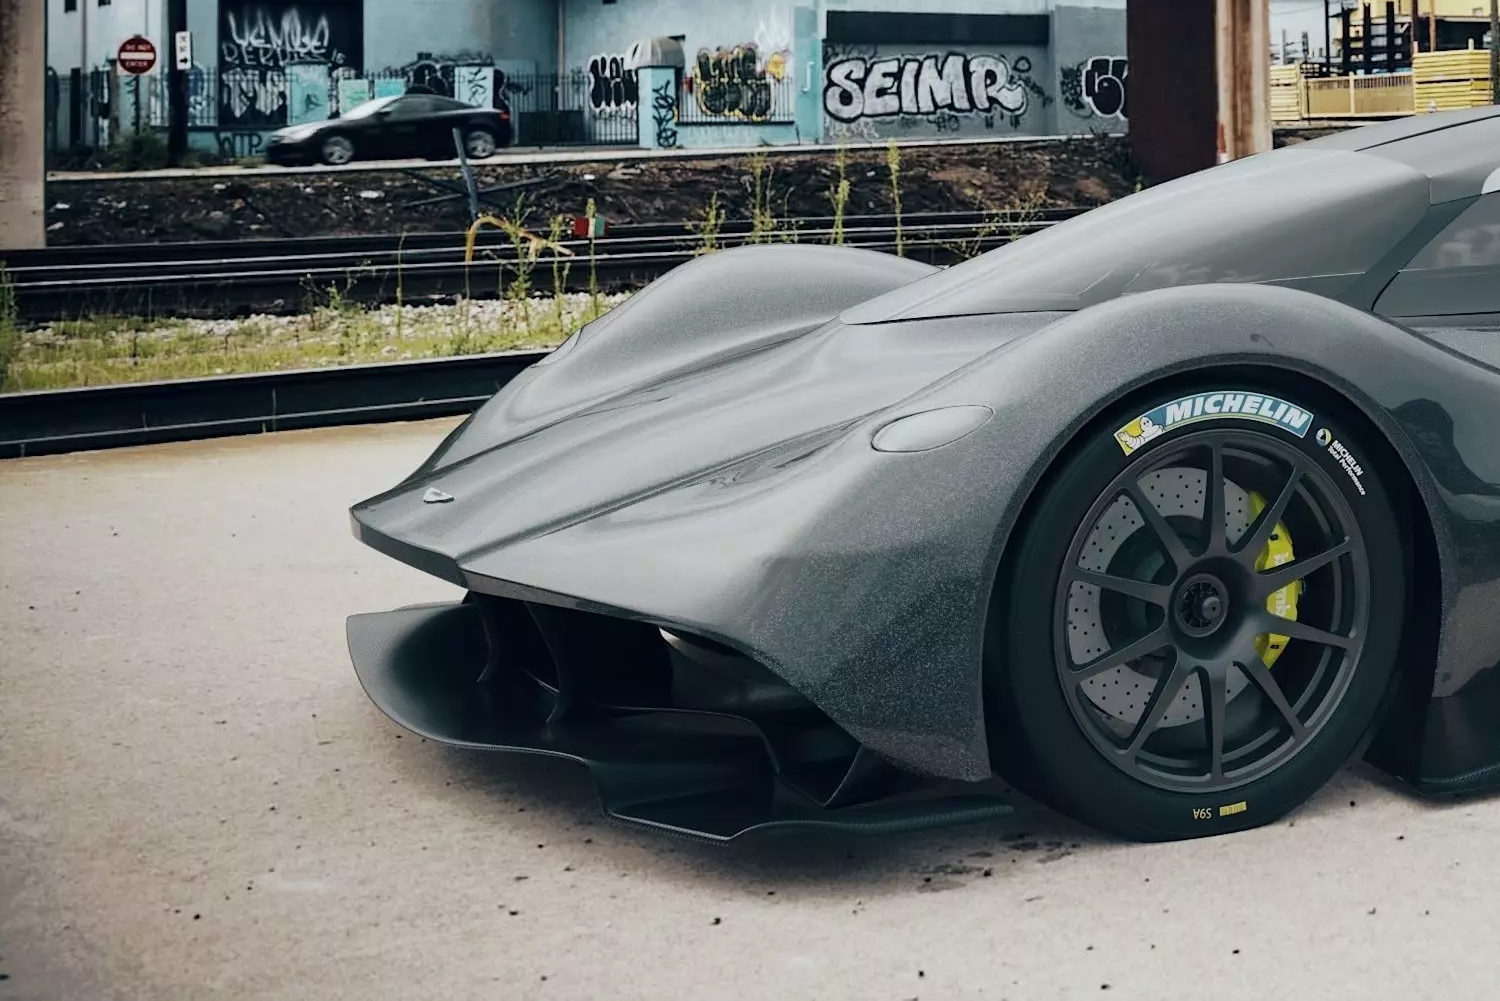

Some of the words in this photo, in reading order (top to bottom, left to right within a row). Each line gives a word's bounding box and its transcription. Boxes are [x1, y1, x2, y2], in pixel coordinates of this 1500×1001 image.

[1165, 394, 1309, 430] MICHELIN
[1328, 446, 1341, 460] Total
[1339, 458, 1366, 495] Performance
[1332, 440, 1363, 476] MICHELIN
